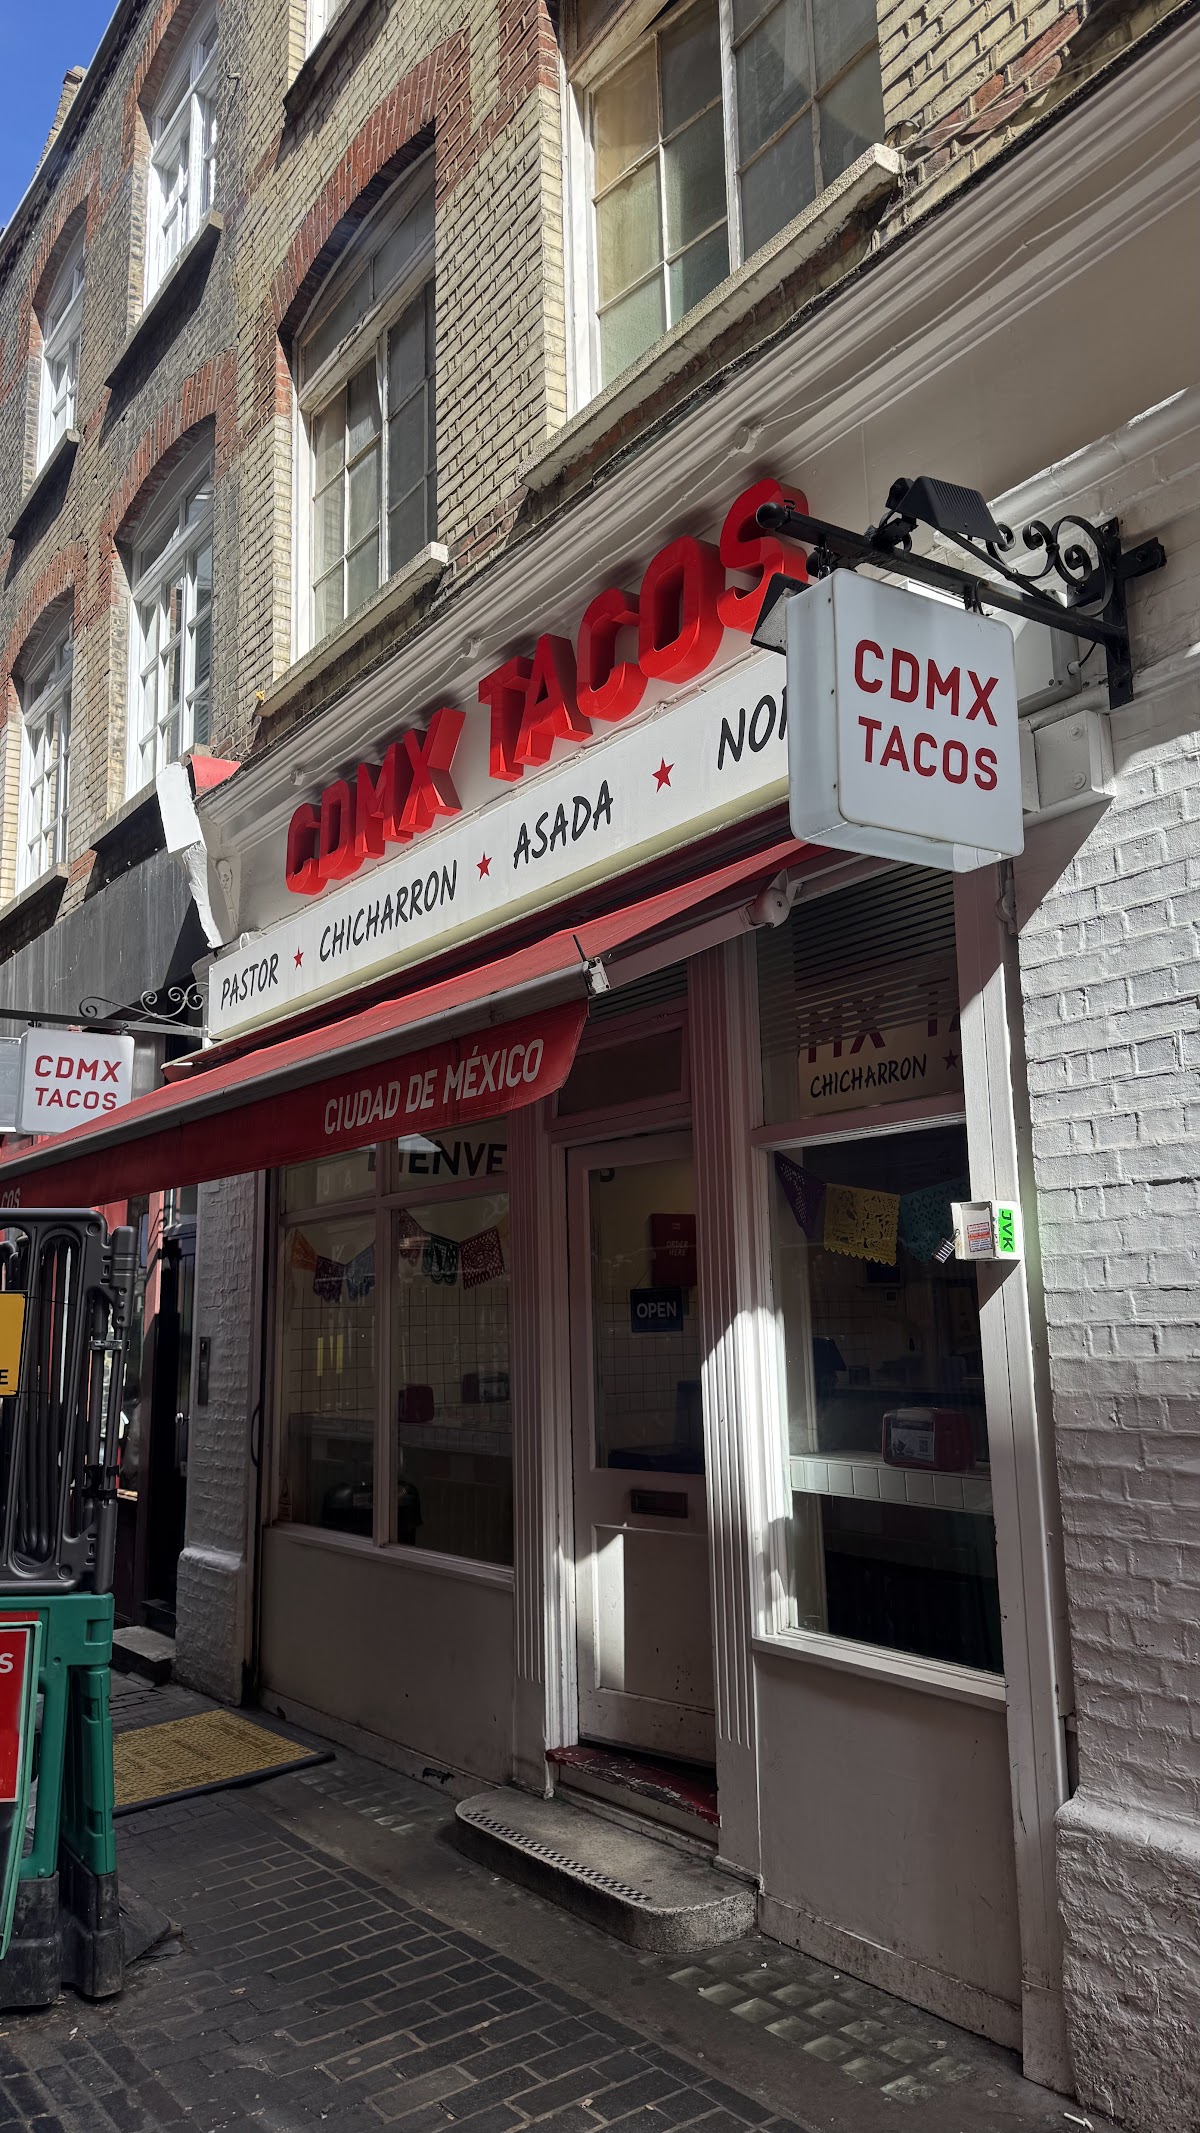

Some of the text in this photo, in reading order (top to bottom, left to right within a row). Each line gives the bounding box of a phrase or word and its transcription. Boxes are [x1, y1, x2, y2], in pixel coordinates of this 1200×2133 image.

[286, 477, 810, 895] CDMX TACOS
[854, 639, 1000, 727] CDMX
[857, 715, 999, 791] TACOS
[220, 953, 280, 1010] PASTOR
[319, 859, 458, 963] CHICHARRON
[513, 779, 614, 869] ASADA
[34, 1054, 122, 1083] CDMX
[324, 1038, 545, 1135] CIUDAD DE MÉXICO
[810, 1053, 927, 1098] CHICHARRON
[35, 1087, 118, 1111] TACOS
[666, 1240, 689, 1249] ORDER
[1001, 1210, 1014, 1251] JVK
[669, 1248, 687, 1257] HERE
[636, 1300, 677, 1319] OPEN
